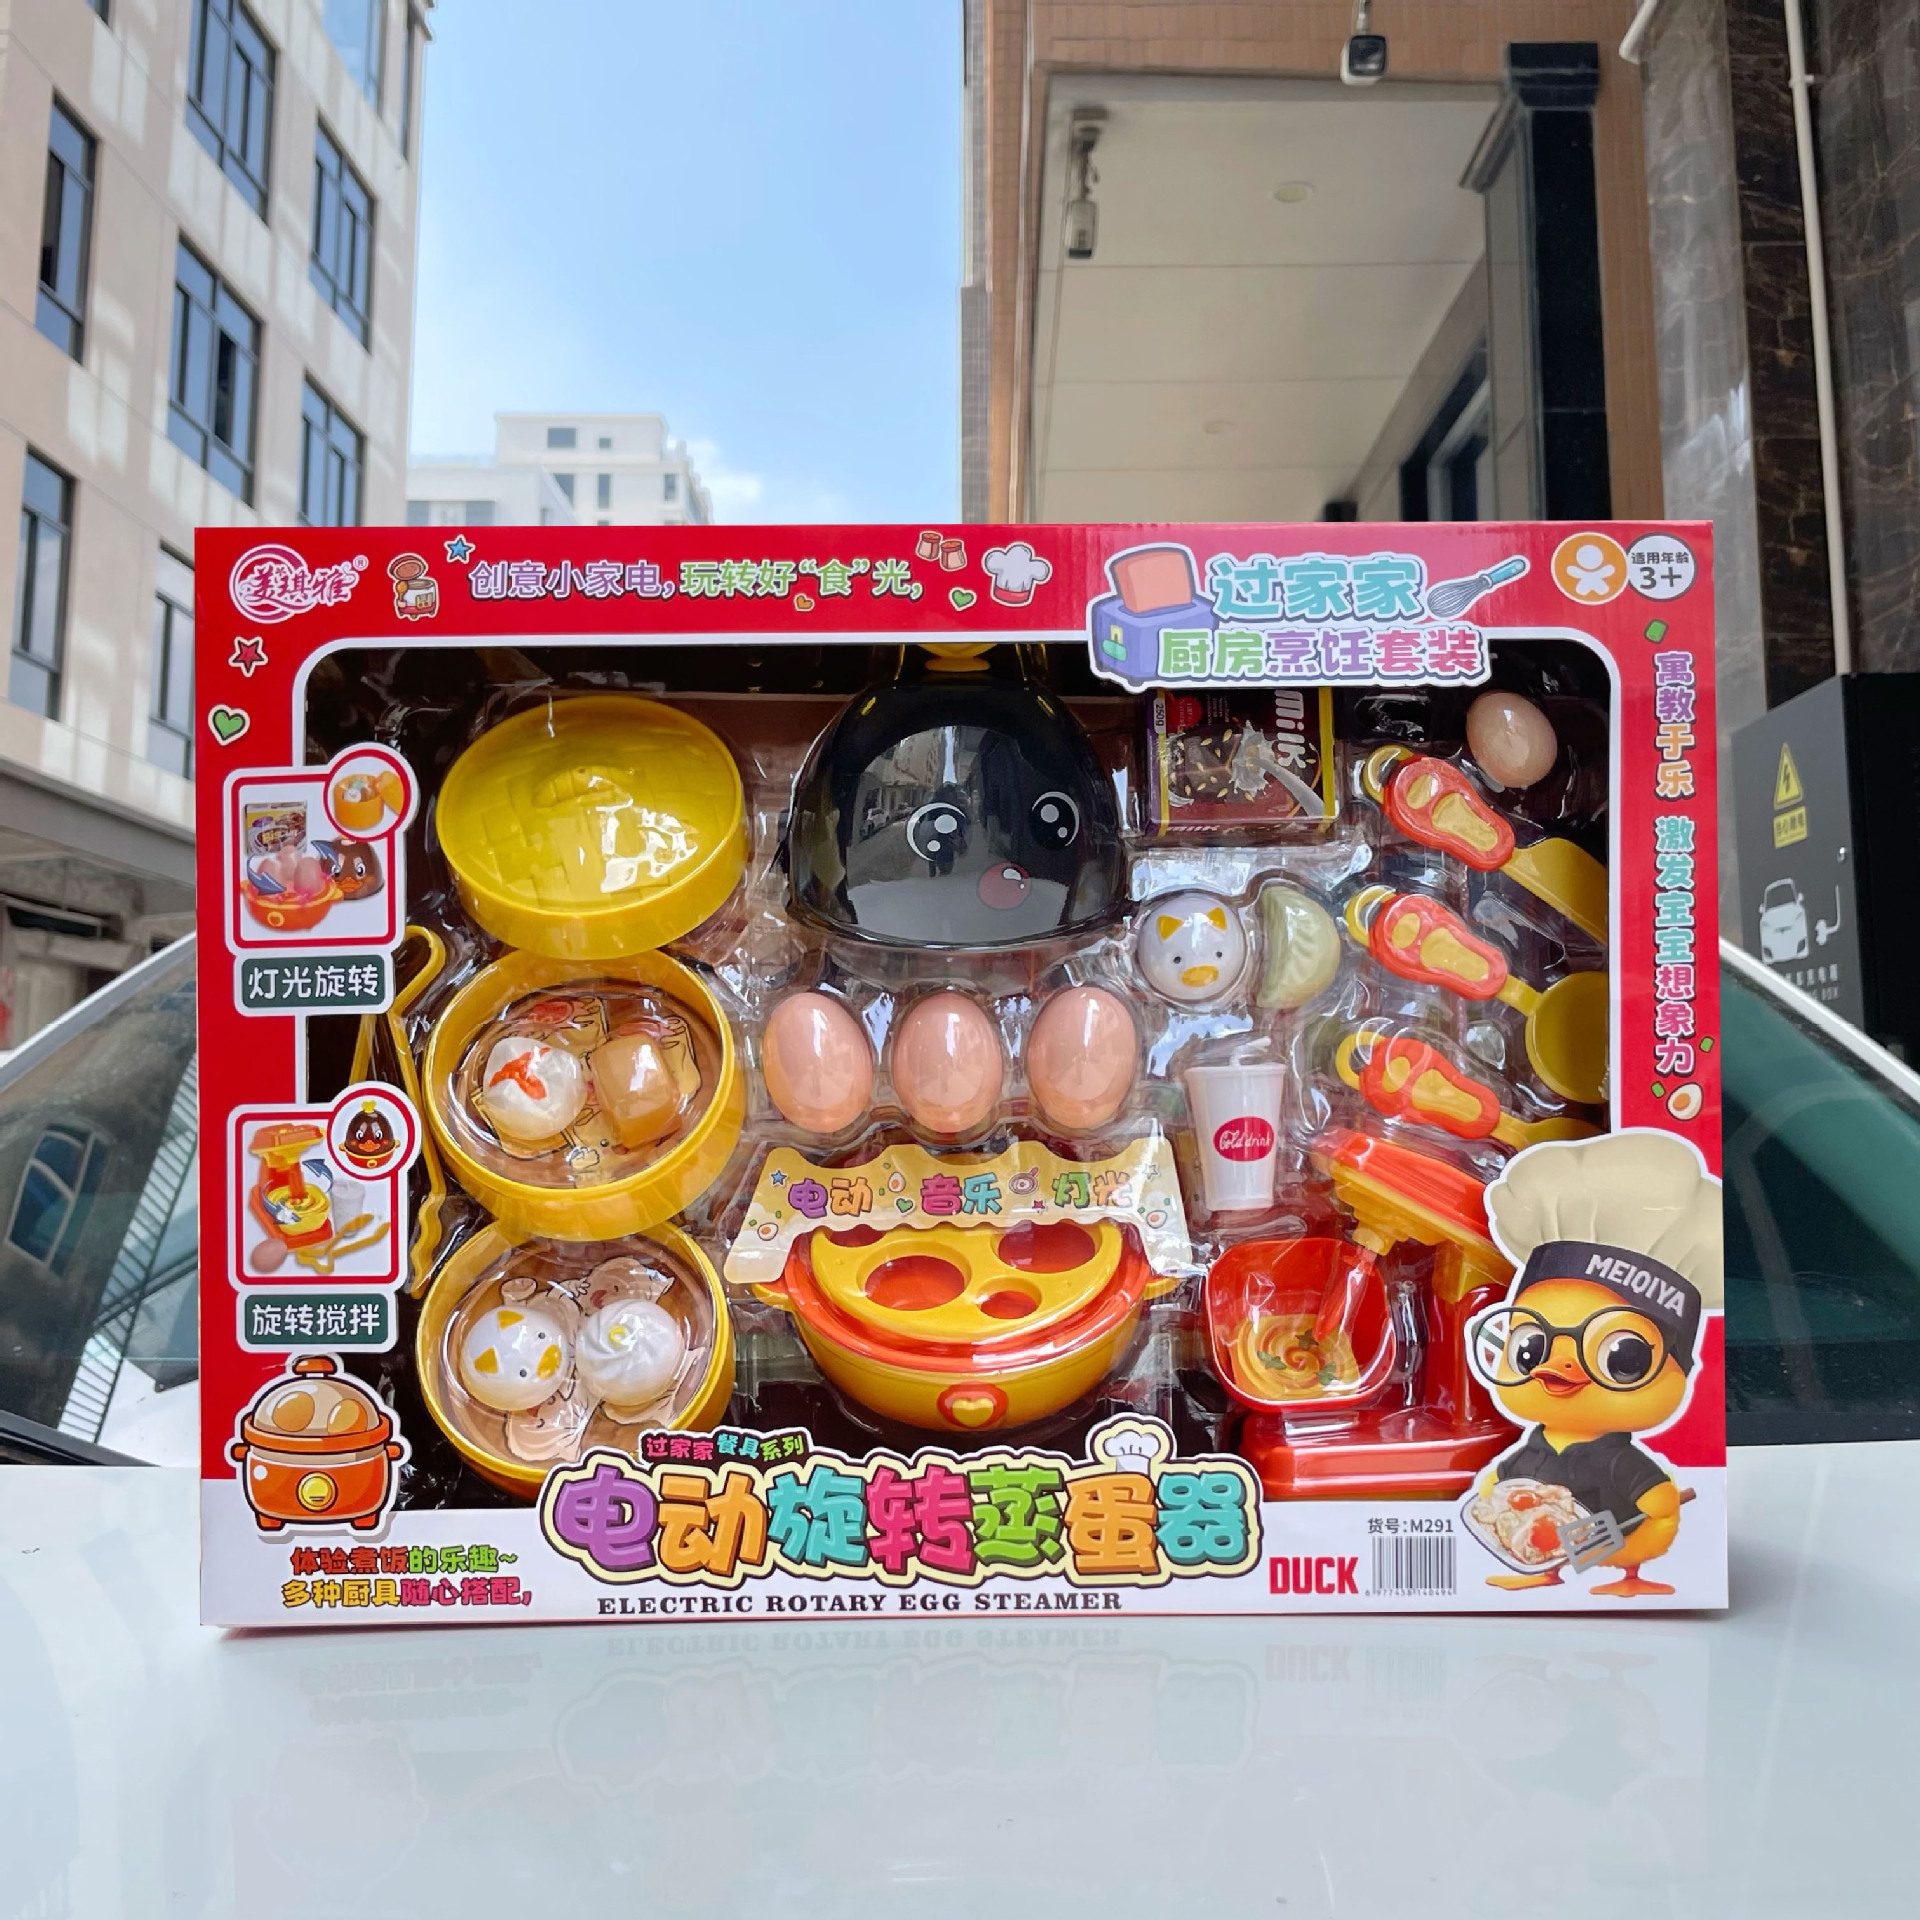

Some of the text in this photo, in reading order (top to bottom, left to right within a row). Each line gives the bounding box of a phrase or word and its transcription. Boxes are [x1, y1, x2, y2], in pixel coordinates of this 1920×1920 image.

[1631, 551, 1690, 565] 适用年龄
[1211, 557, 1424, 620] 过家家
[1639, 566, 1682, 590] 3+
[1160, 628, 1481, 677] 厨房烹饪套装
[1653, 651, 1698, 1076] 寓教于乐 激发宝宝想象力
[247, 963, 379, 1000] 灯光旋转
[787, 1169, 1133, 1219] 电动 音乐 灯光
[1584, 1254, 1687, 1317] MEIQIYA
[251, 1303, 382, 1337] 旋转搅拌
[645, 1433, 805, 1462] 过家家餐具系列
[552, 1462, 1249, 1578] 电动旋转蒸蛋器
[1367, 1518, 1454, 1534] 货号:M291
[1269, 1557, 1359, 1594] DUCK
[597, 1591, 1123, 1616] ELECTRIC ROTARY EGG STEAMER
